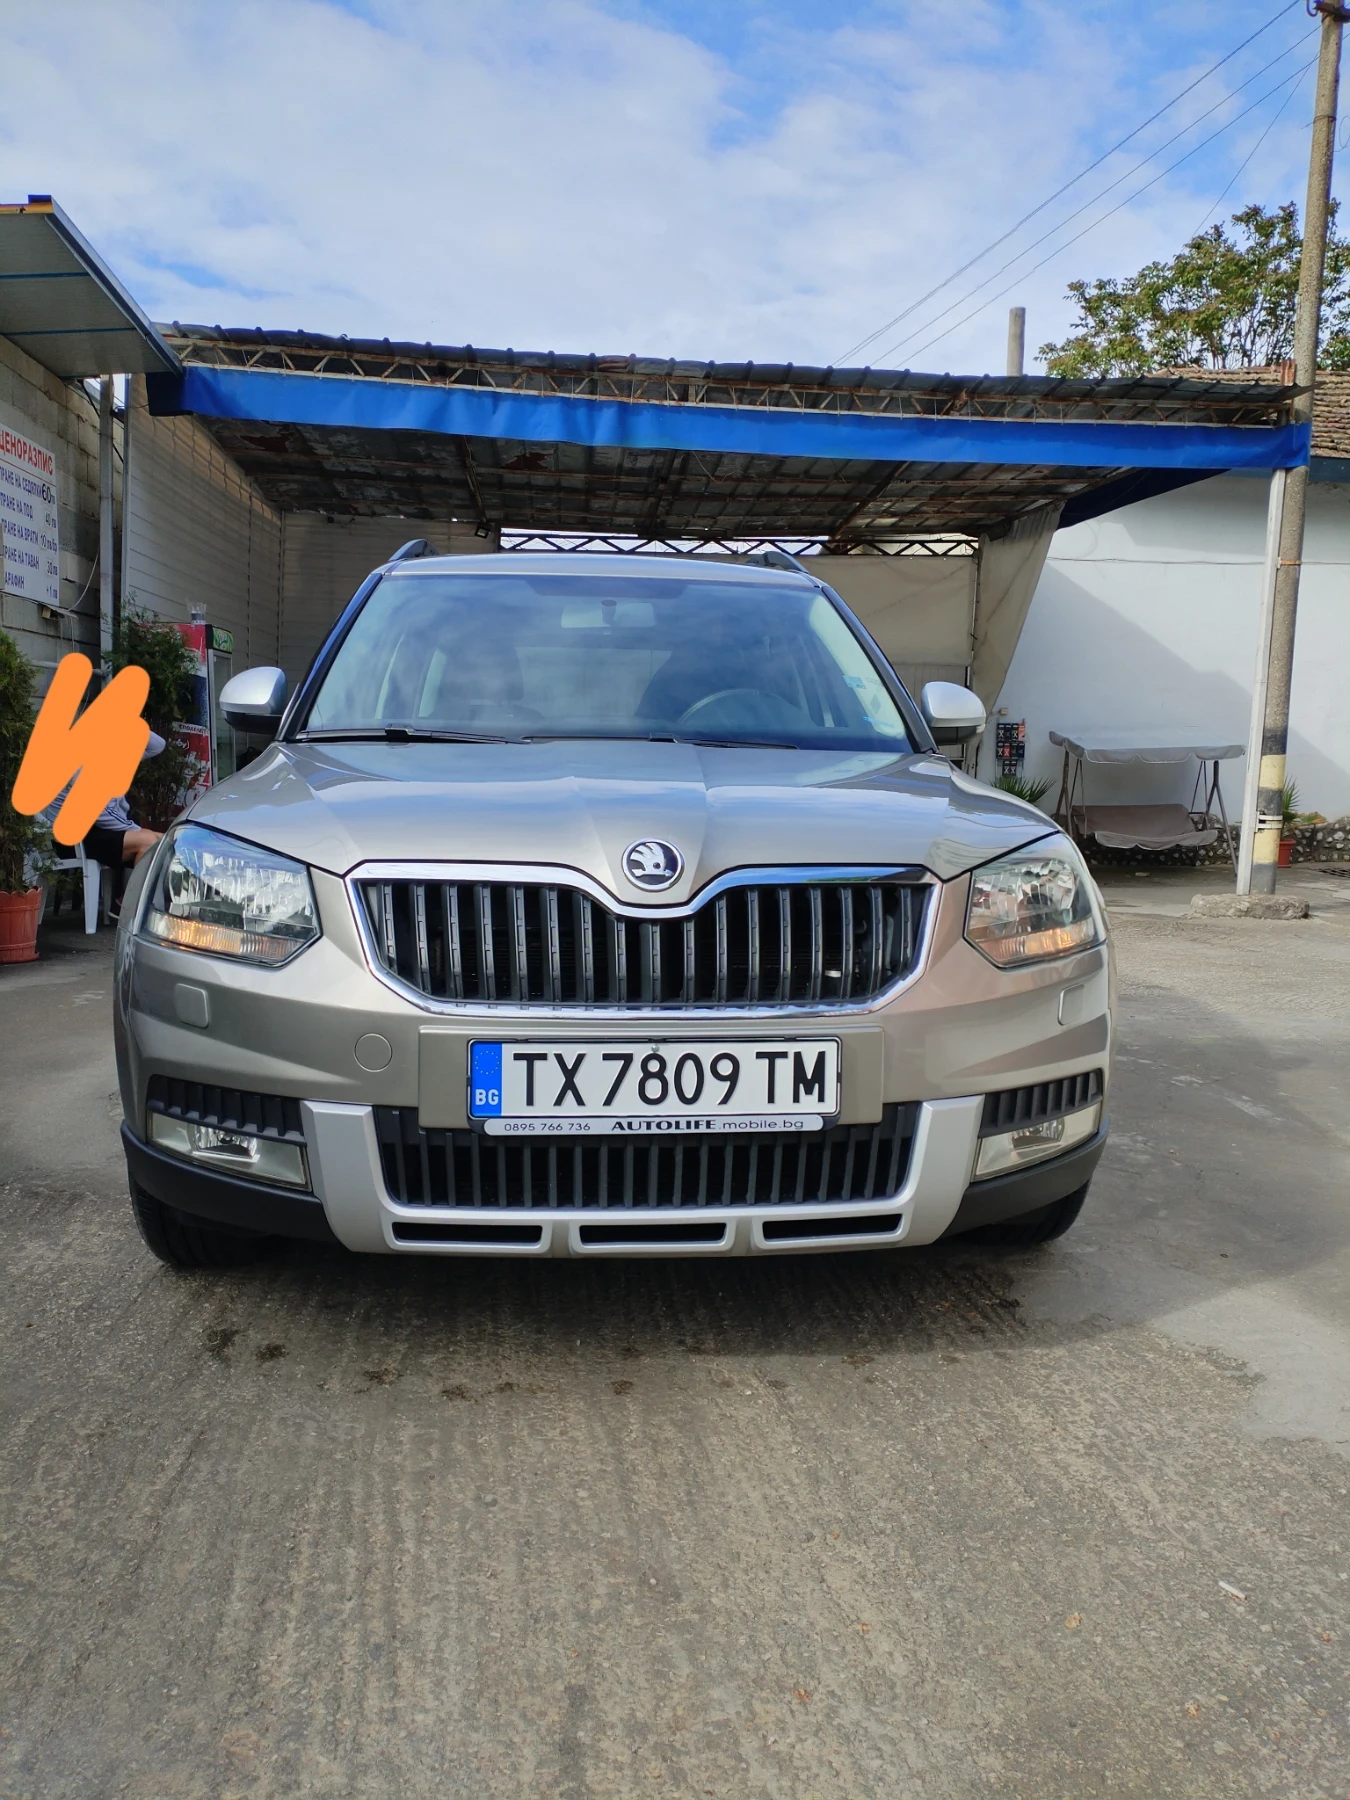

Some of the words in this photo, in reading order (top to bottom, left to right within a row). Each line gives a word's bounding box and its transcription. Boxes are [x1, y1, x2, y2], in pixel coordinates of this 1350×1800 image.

[42, 483, 52, 504] 60
[16, 499, 23, 515] НА
[16, 524, 24, 539] НА
[17, 549, 24, 565] НА
[475, 1089, 499, 1106] BG
[513, 1052, 586, 1107] TX
[602, 1052, 740, 1107] 7809
[755, 1051, 826, 1105] TM
[504, 1123, 535, 1131] 0895
[541, 1123, 563, 1131] 766
[568, 1123, 590, 1131] 736
